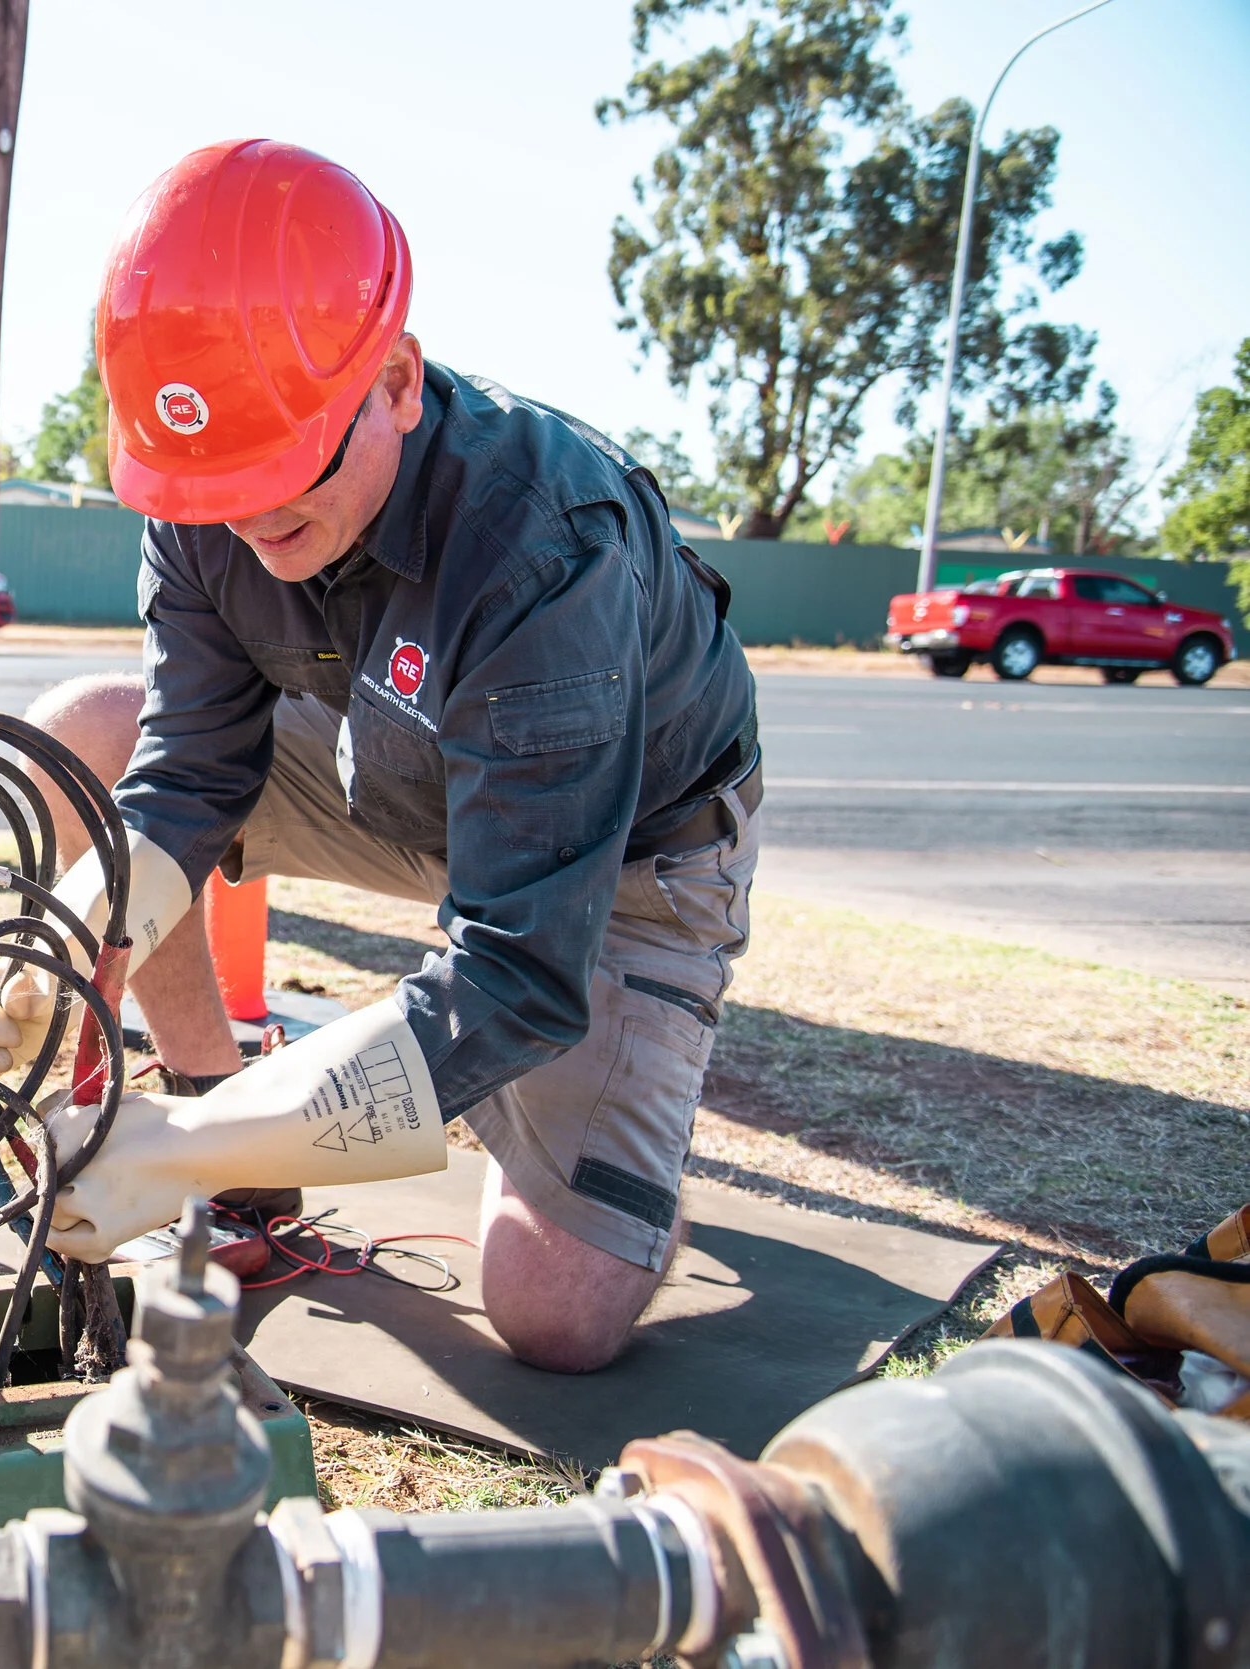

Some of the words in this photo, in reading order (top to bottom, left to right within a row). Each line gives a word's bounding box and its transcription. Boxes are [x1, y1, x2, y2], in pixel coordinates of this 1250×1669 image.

[171, 404, 193, 415] RE
[396, 656, 420, 681] RE
[361, 673, 375, 689] RED
[374, 684, 399, 707] EARTH
[398, 700, 439, 732] ELECTRICAL
[325, 1067, 349, 1110] Honeywell
